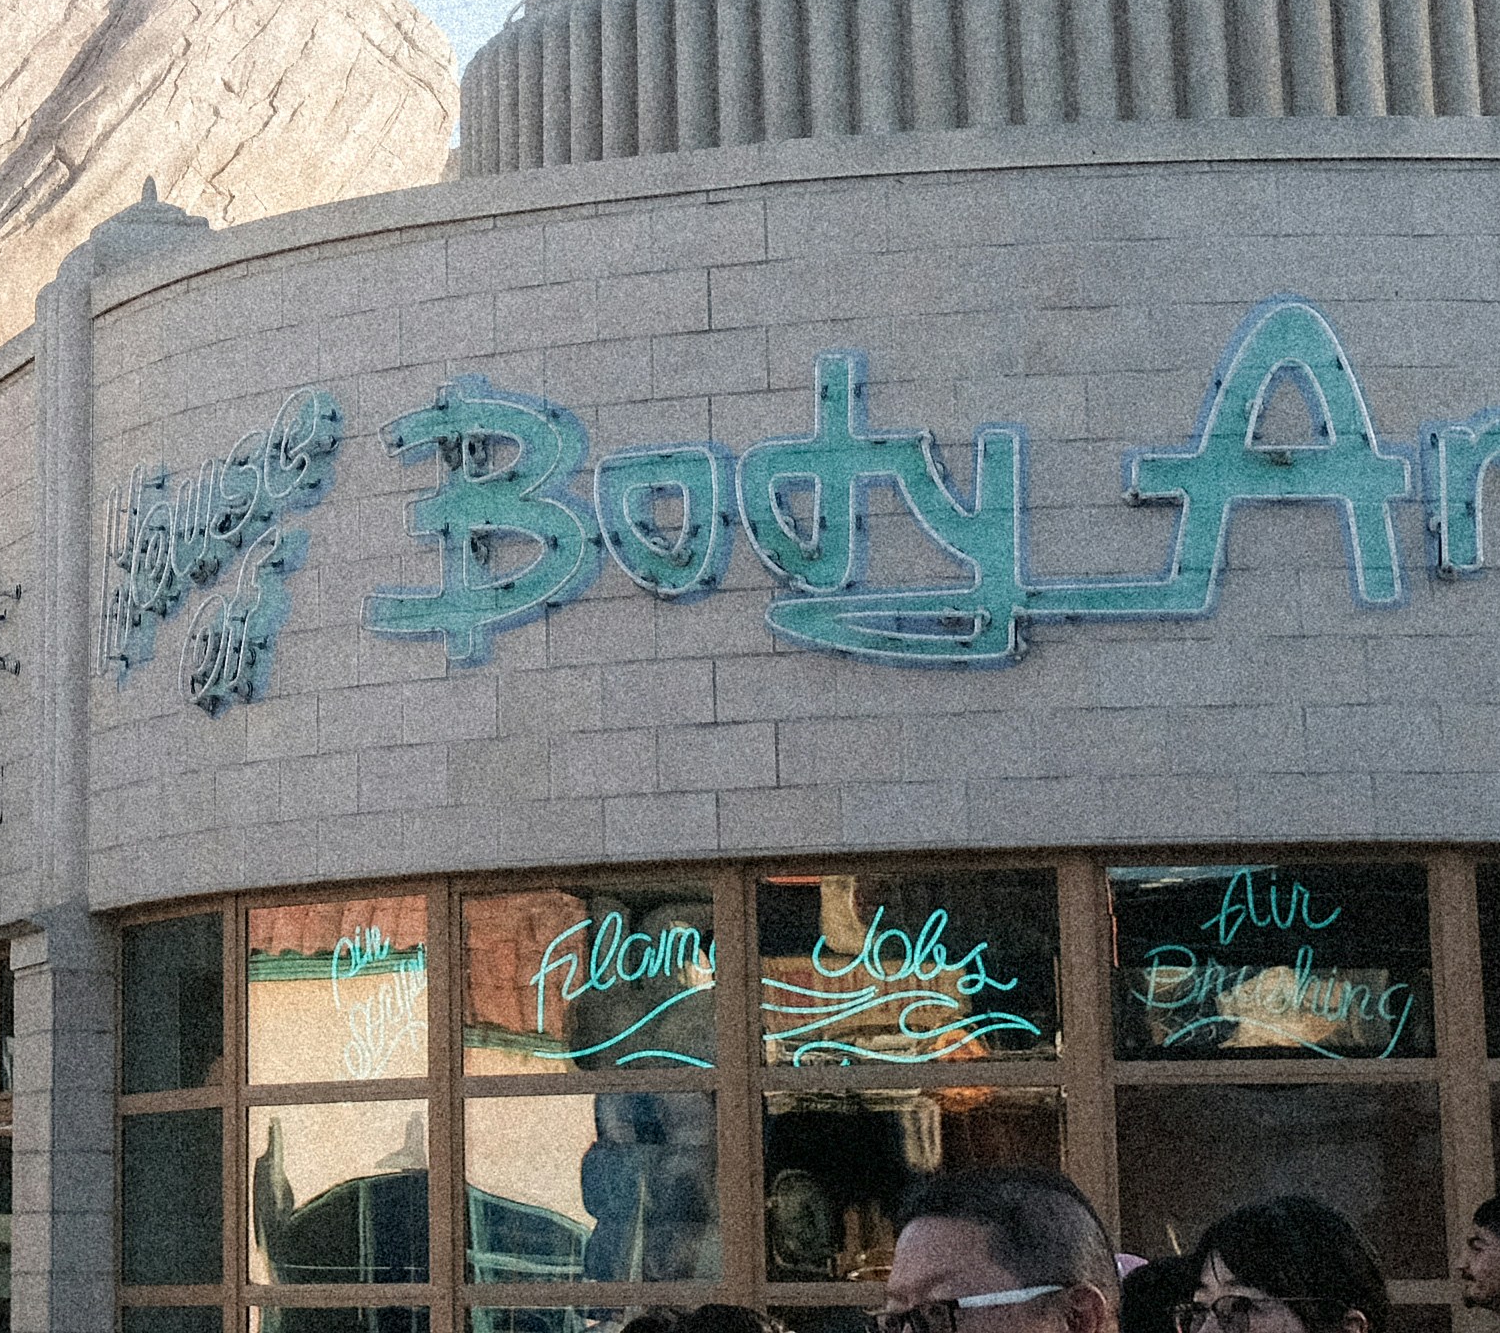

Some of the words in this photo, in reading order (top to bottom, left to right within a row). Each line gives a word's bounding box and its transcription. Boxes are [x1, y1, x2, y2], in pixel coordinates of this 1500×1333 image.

[99, 385, 338, 685] House
[361, 349, 1025, 668] Body
[178, 525, 308, 713] of
[529, 911, 717, 1034] Flam
[812, 905, 1019, 996] Jobs
[1200, 867, 1342, 945] Air
